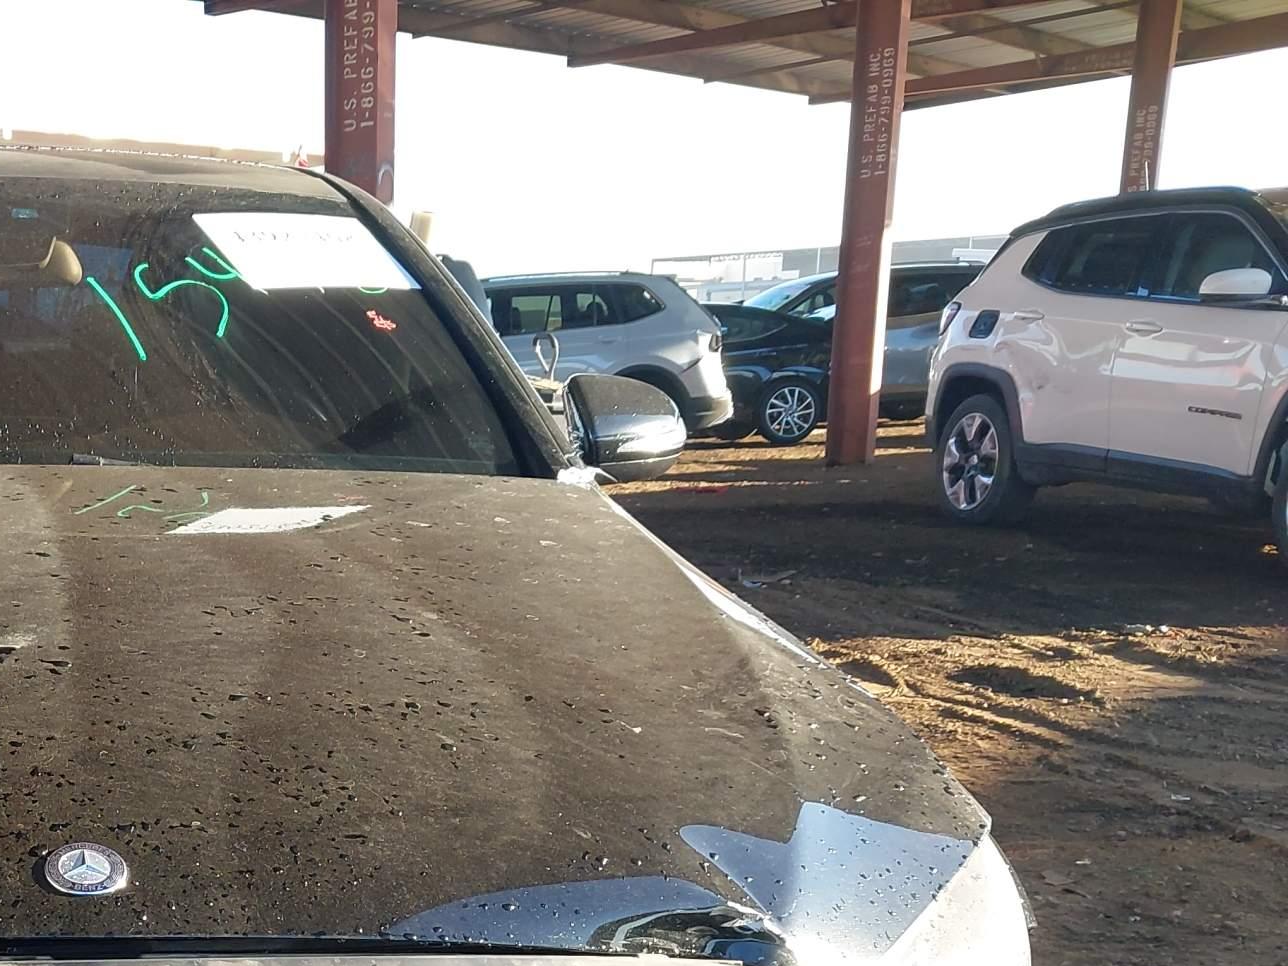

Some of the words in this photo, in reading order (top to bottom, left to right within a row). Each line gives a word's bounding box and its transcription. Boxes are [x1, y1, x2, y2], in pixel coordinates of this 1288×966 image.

[344, 90, 357, 132] U.S.
[863, 83, 879, 142] PREFAB
[874, 47, 895, 176] 1-866-799-0969
[860, 149, 874, 179] U.S.
